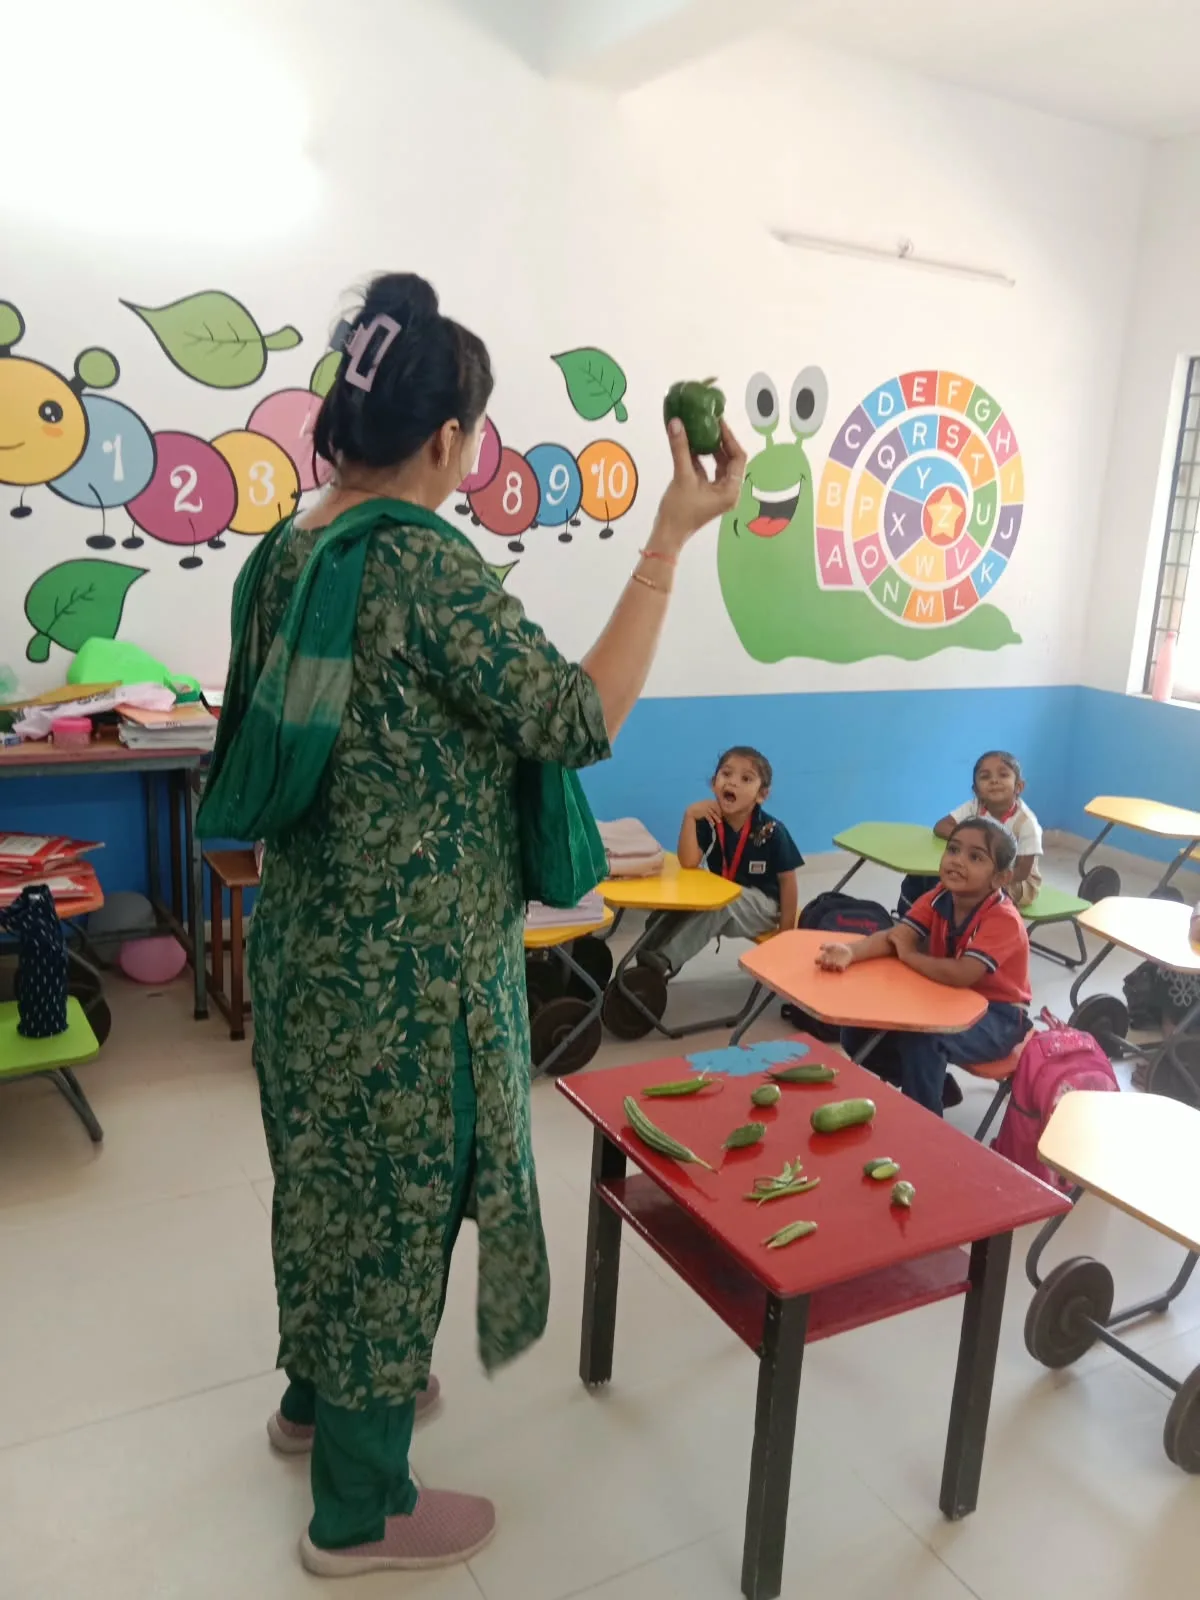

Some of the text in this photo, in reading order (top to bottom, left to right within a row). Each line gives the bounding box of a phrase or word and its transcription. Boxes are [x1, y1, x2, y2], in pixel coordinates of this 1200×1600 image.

[912, 377, 927, 402] E
[947, 382, 962, 404] F
[878, 392, 894, 417] D
[974, 400, 991, 421] G
[844, 425, 861, 449] C
[912, 422, 928, 446] R
[946, 424, 960, 448] S
[996, 430, 1011, 453] H
[102, 434, 125, 482] 1
[877, 447, 897, 470] Q
[971, 453, 984, 475] T
[249, 461, 275, 506] 3
[545, 463, 570, 506] 9
[591, 457, 628, 499] 10
[917, 466, 932, 488] Y
[1010, 472, 1016, 491] I
[170, 465, 203, 513] 2
[502, 471, 522, 515] 8
[827, 482, 842, 507] B
[859, 496, 874, 518] P
[938, 505, 952, 528] Z
[976, 503, 990, 525] U
[889, 513, 905, 537] X
[1000, 517, 1014, 540] J
[826, 545, 843, 568] A
[861, 545, 879, 568] O
[915, 555, 935, 577] W
[954, 547, 970, 570] V
[981, 562, 993, 584] K
[883, 581, 900, 603] N
[953, 587, 965, 610] L
[915, 595, 934, 617] M
